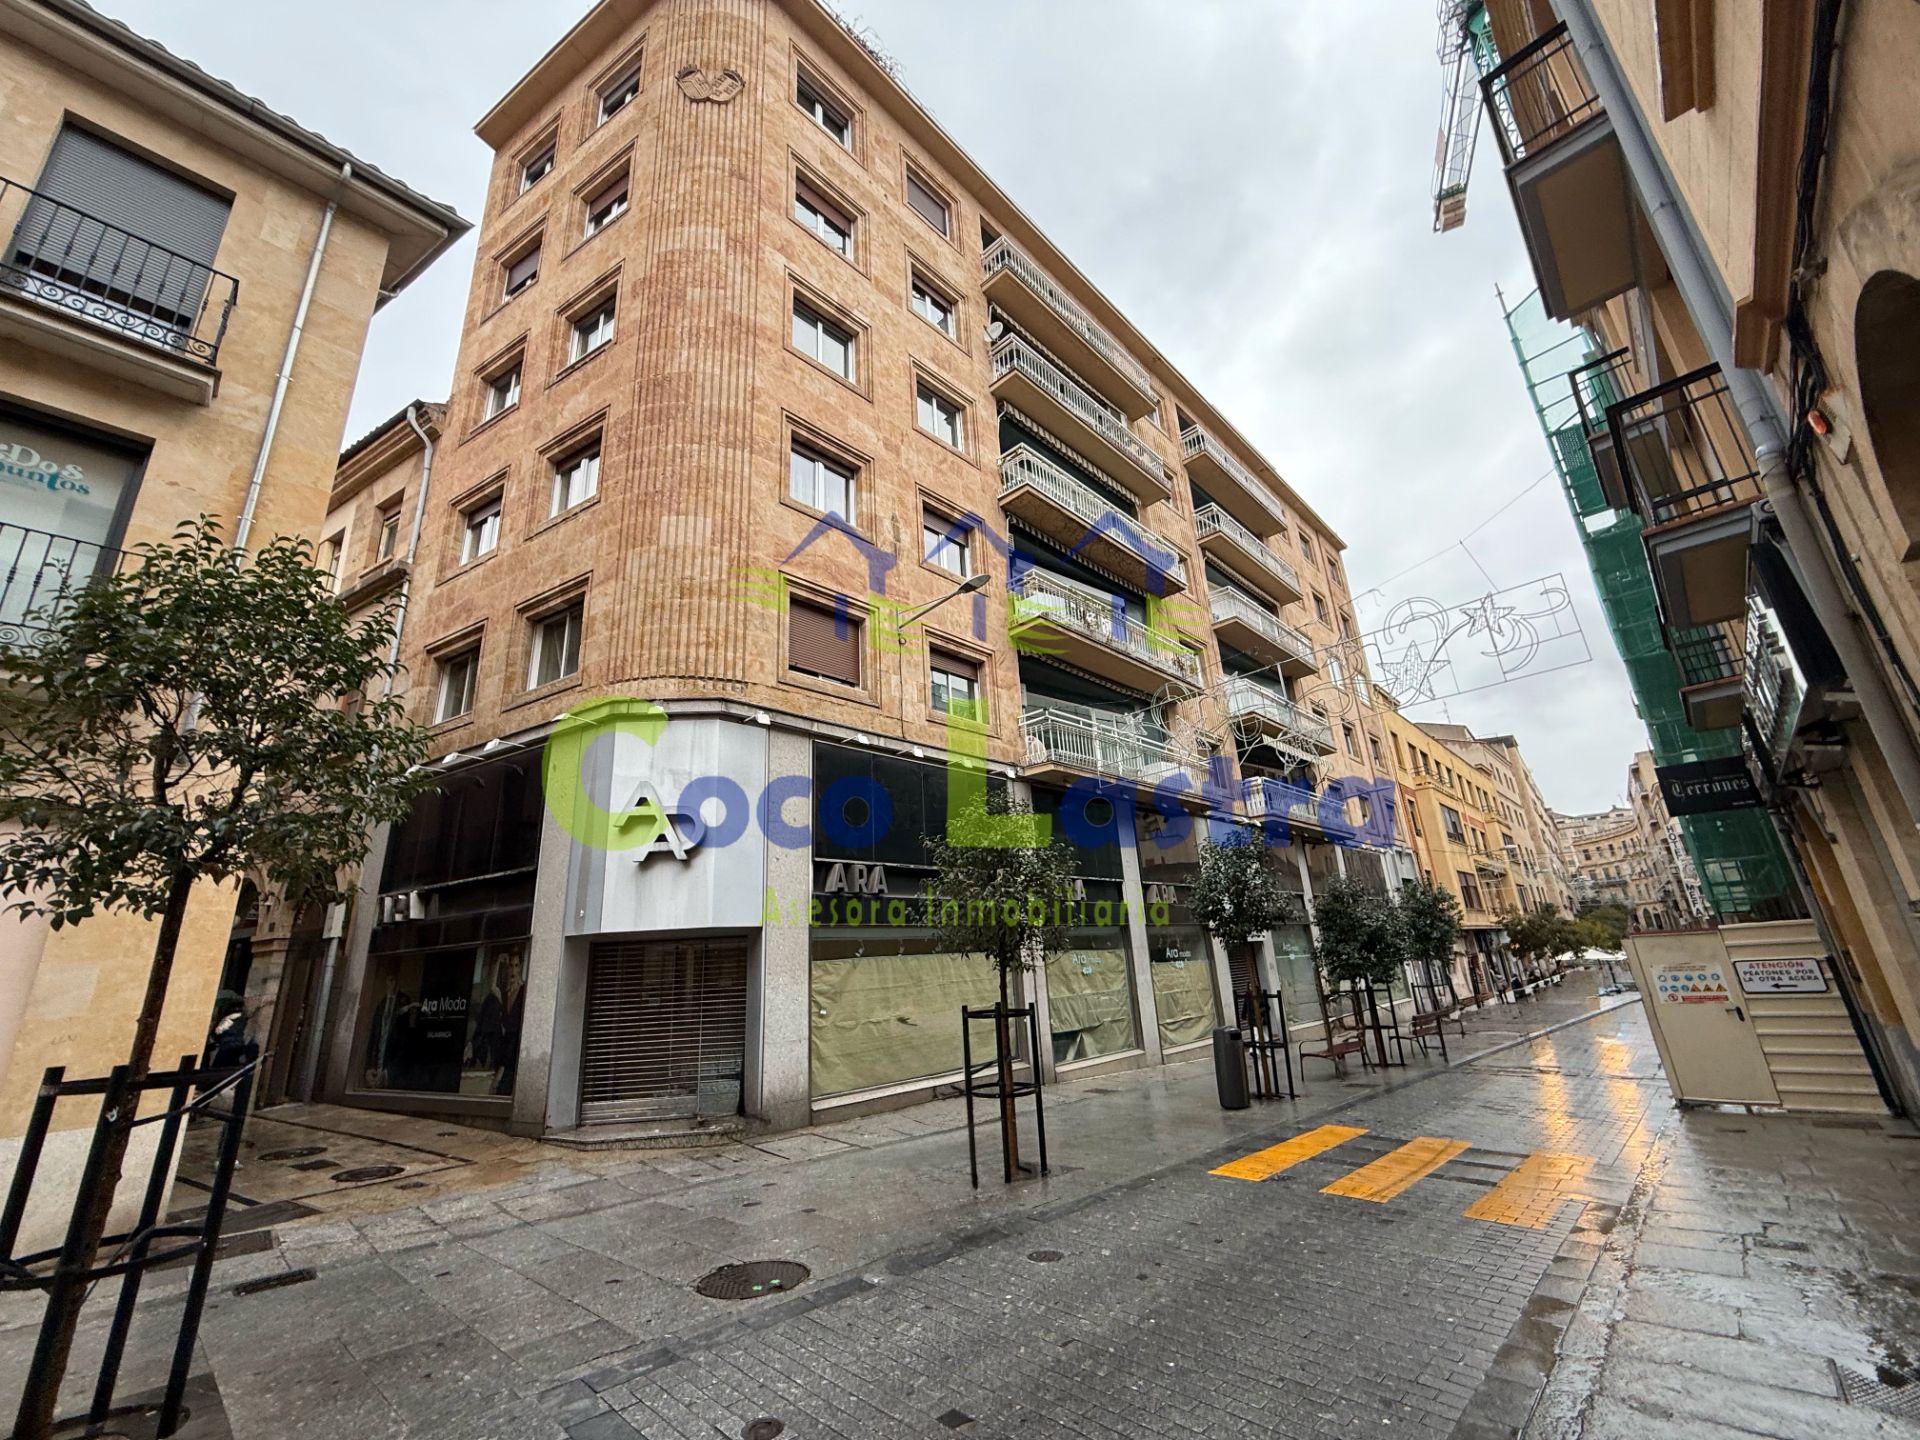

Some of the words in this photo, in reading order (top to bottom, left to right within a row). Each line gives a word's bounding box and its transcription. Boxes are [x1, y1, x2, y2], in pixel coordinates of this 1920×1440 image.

[825, 863, 888, 894] ARA
[1147, 885, 1178, 904] ARA
[421, 998, 438, 1014] Ara
[439, 997, 467, 1012] Moda
